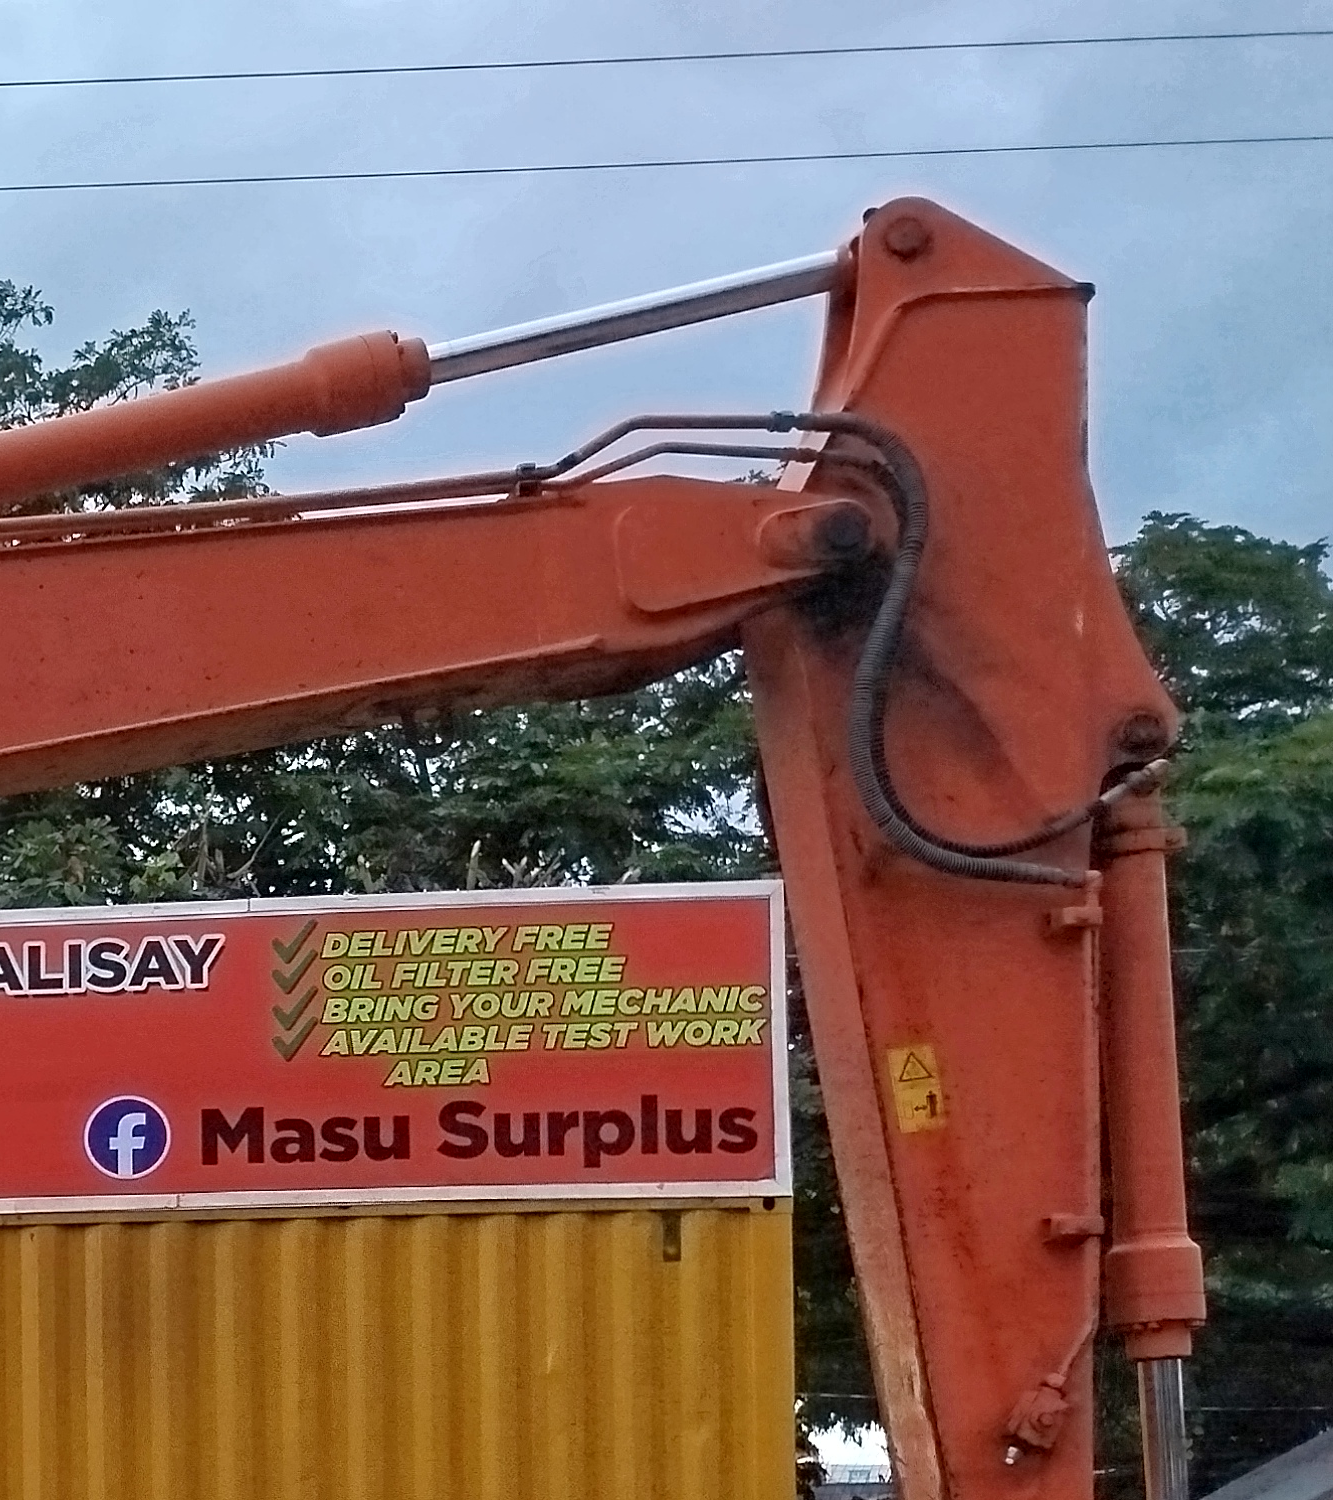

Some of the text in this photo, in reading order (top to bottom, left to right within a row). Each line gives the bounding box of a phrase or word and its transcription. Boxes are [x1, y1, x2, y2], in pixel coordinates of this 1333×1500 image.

[321, 923, 614, 958] DELIVERY FREE
[322, 956, 627, 991] OIL FILTER FREE
[321, 985, 766, 1025] BRING YOUR MECHANIC
[321, 1018, 766, 1057] AVAILABLE TEST WORK
[384, 1058, 490, 1087] AREA
[201, 1094, 759, 1168] Masu Surplus
